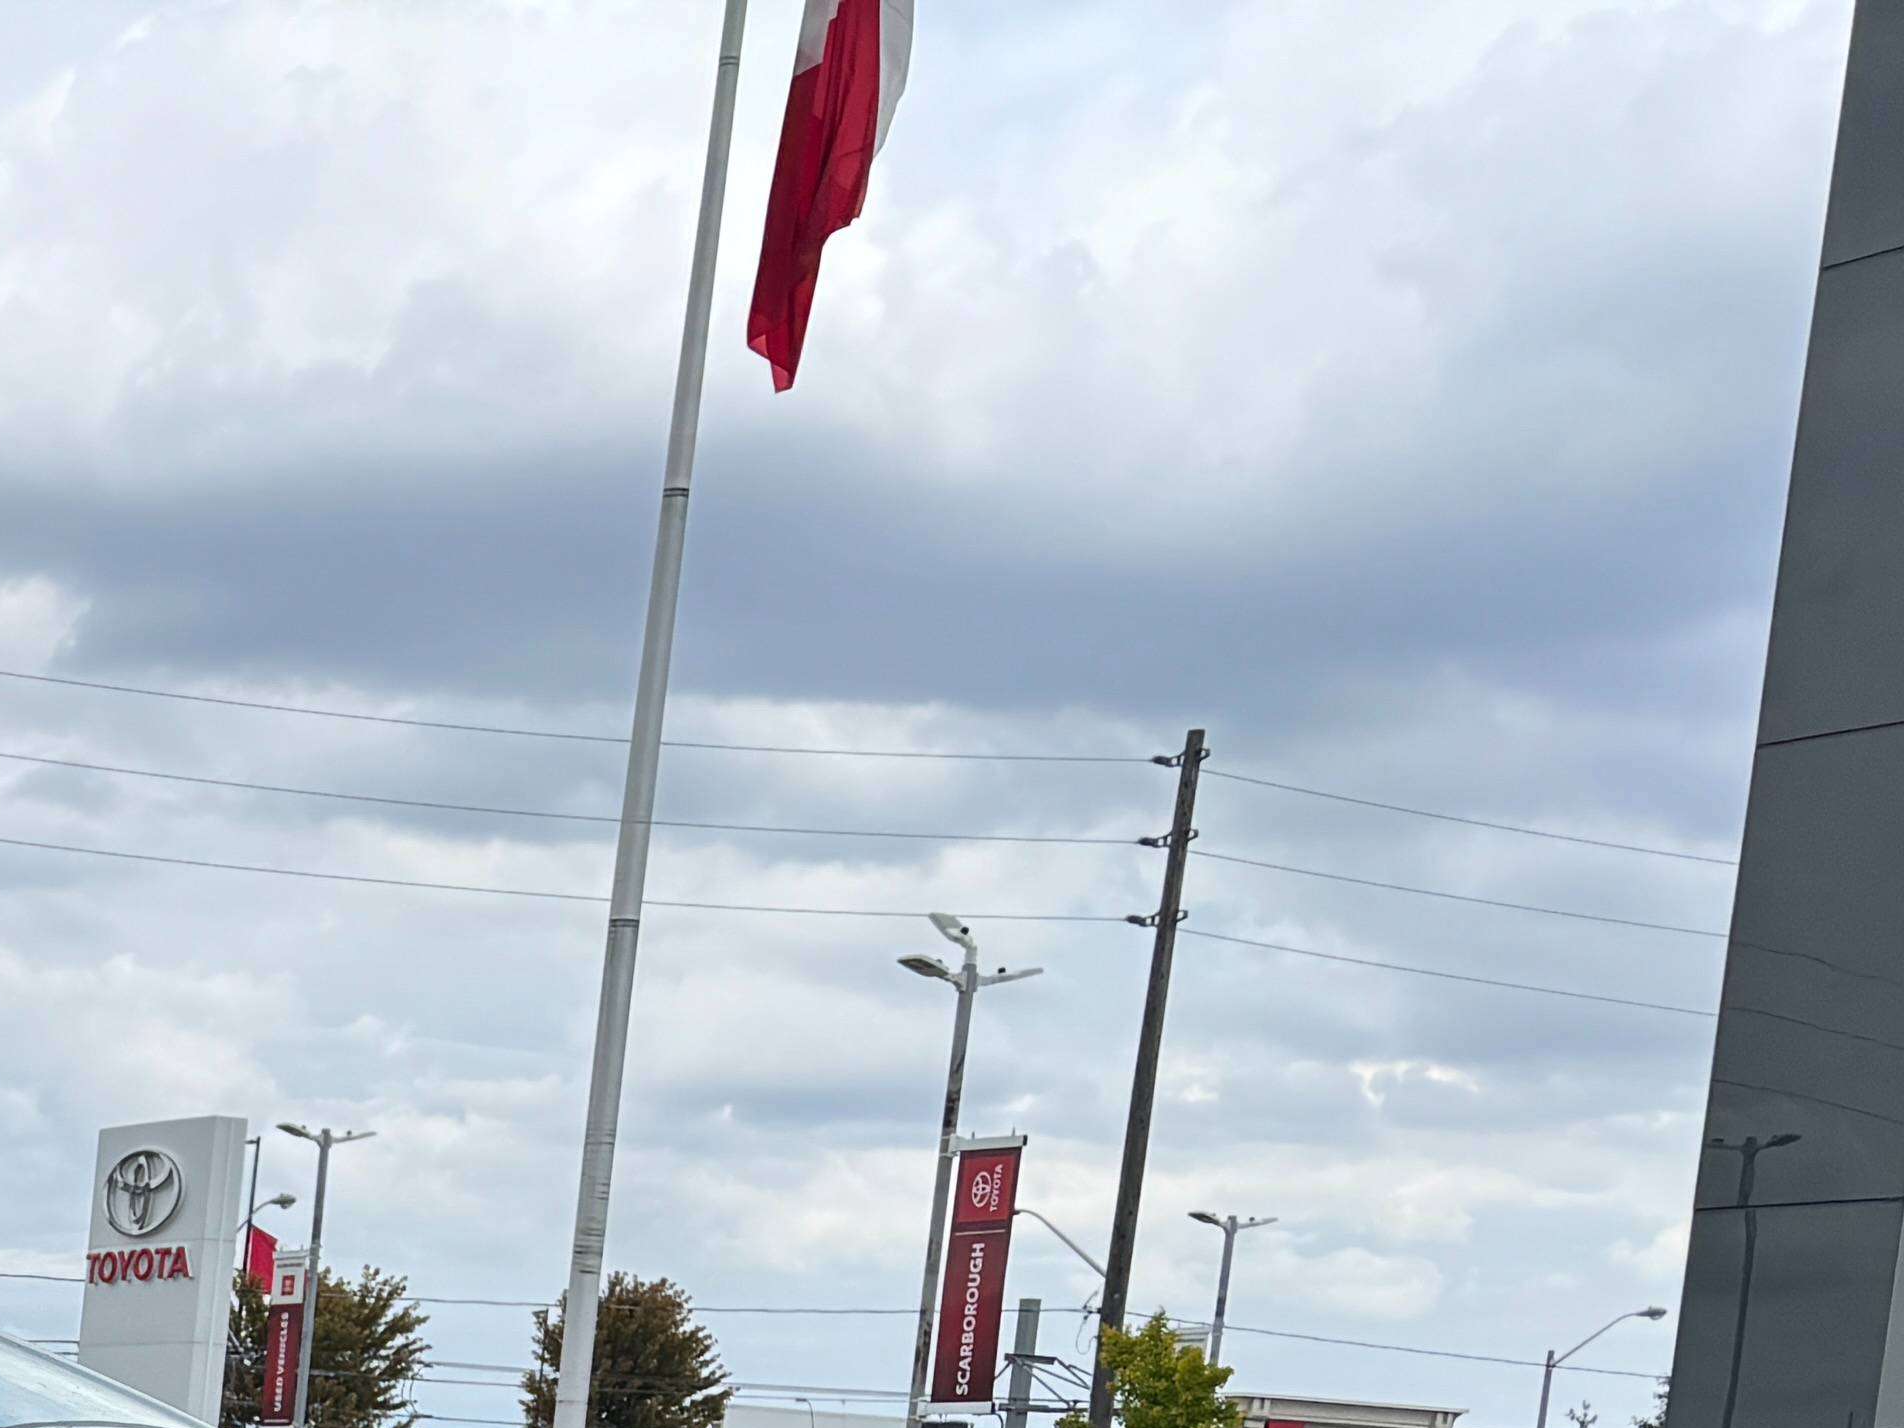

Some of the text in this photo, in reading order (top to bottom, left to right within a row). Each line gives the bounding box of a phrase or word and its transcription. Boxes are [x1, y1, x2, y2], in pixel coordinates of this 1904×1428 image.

[989, 1164, 1003, 1212] TOYOTA
[86, 1246, 194, 1286] TOYOTA
[955, 1242, 985, 1396] SCARBOROUGH
